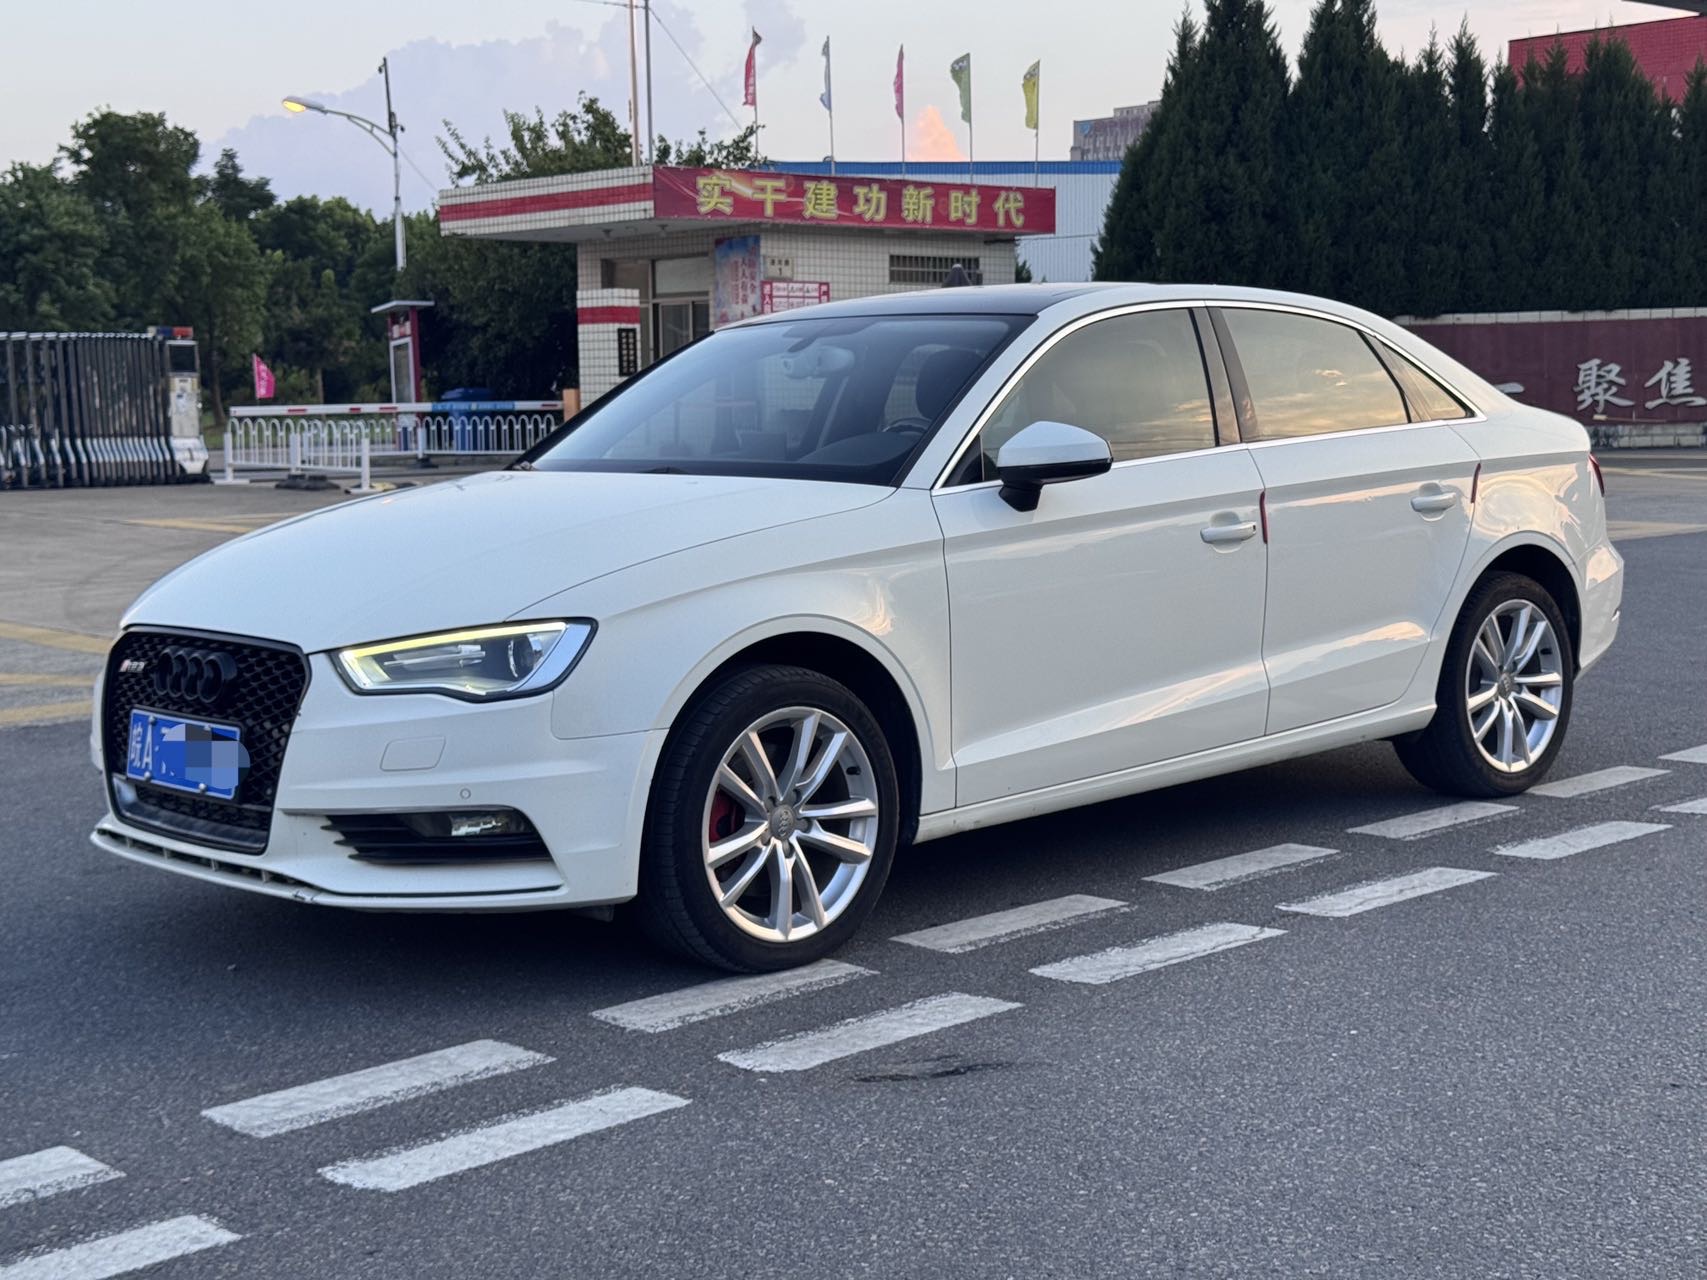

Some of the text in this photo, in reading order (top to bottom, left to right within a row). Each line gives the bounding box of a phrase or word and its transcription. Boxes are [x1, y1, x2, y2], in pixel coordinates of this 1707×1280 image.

[696, 175, 1025, 227] 实干建功新时代
[1572, 357, 1707, 416] 聚焦
